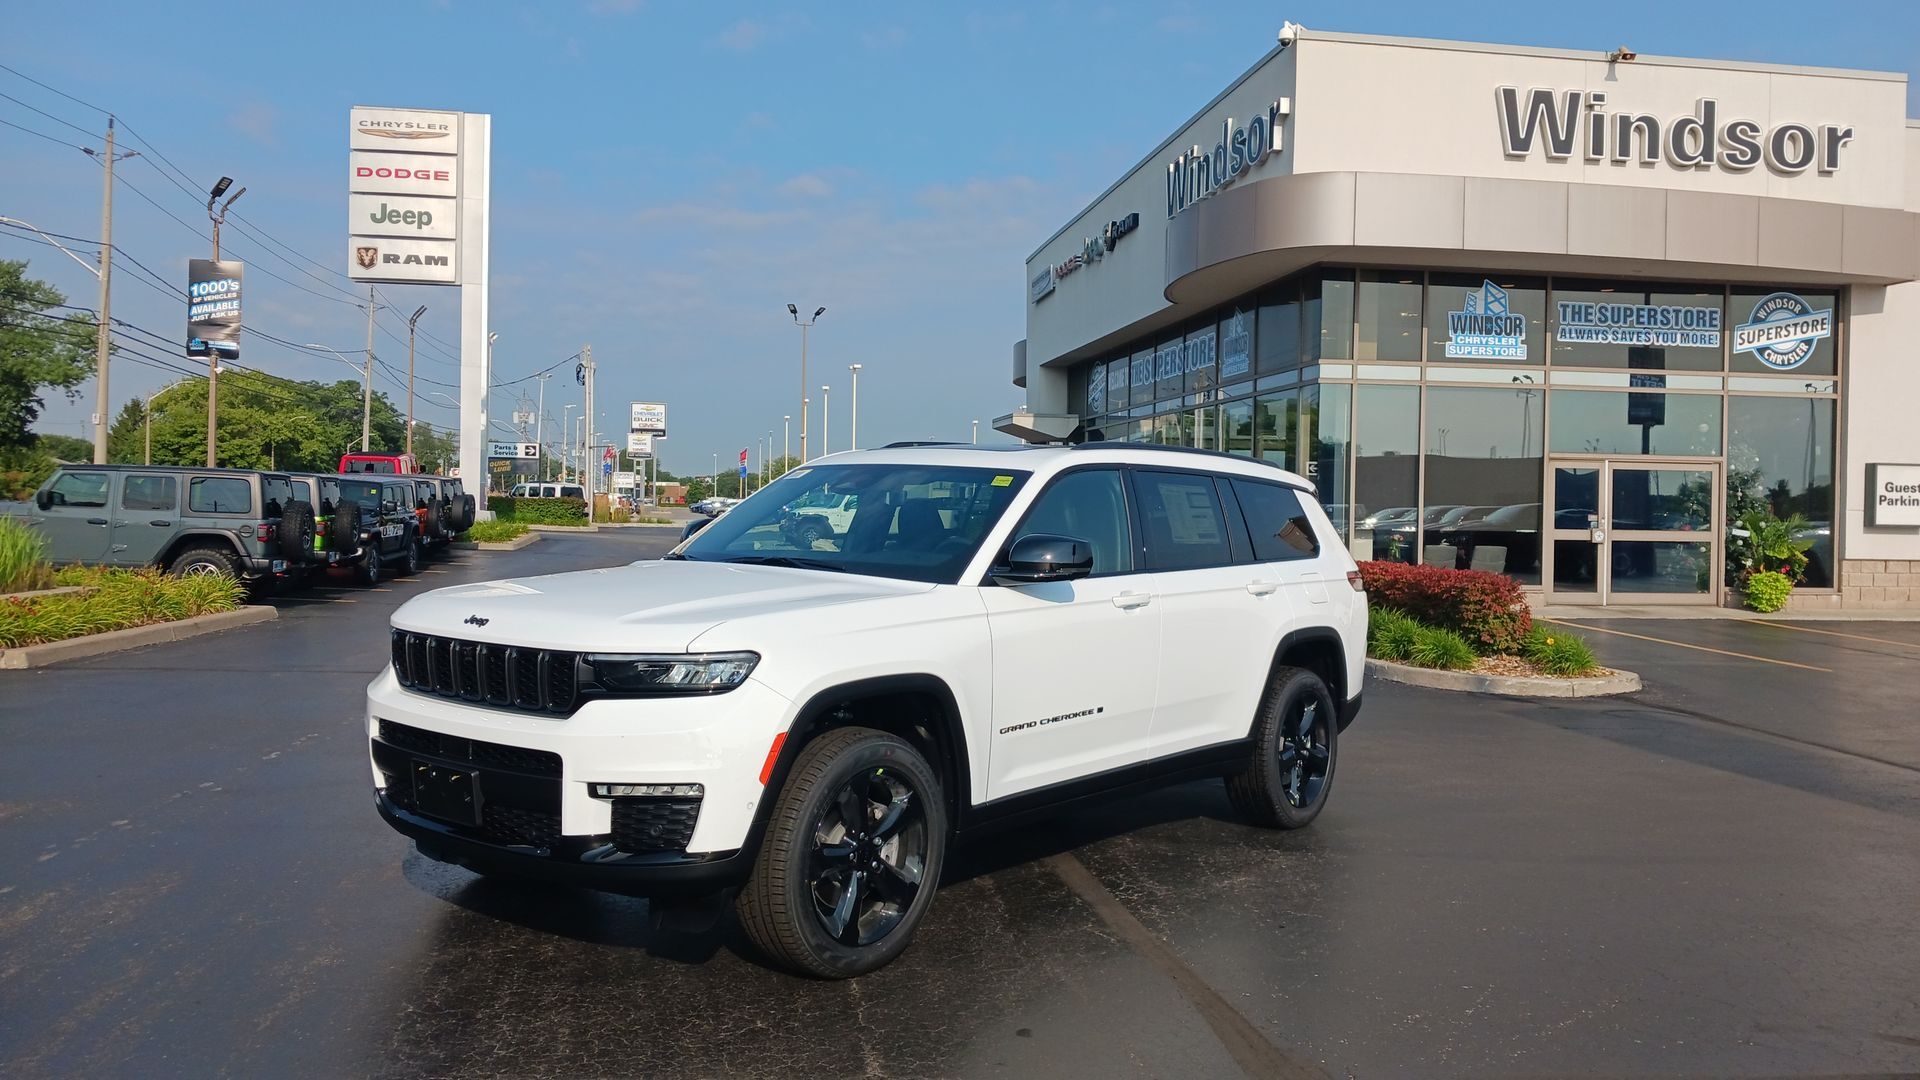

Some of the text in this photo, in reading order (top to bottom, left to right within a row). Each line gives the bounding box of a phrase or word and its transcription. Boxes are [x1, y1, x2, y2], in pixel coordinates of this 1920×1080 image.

[359, 120, 448, 131] CHRYSLER
[1496, 86, 1854, 172] Windsor
[1166, 97, 1290, 220] Windsor
[356, 167, 449, 181] DODGE
[370, 203, 432, 229] Jeep
[382, 253, 448, 266] RAM
[203, 292, 237, 301] VEHICLES
[192, 300, 239, 315] AVAILABLE
[1559, 303, 1719, 328] THE SUPERSTORE
[1757, 298, 1802, 319] WINDSOR
[1451, 315, 1522, 336] WINDSOR
[1738, 317, 1828, 346] SUPERSTORE
[1457, 336, 1516, 345] CHRYSLER
[1560, 328, 1719, 345] ALWAYS SAVES YOU MORE!
[1144, 332, 1216, 385] SUPERSTORE
[1449, 346, 1524, 356] SUPERSTORE
[1764, 342, 1809, 365] CHRYSLER
[1879, 495, 1920, 506] Parkin
[464, 614, 489, 628] Jeep
[1000, 721, 1037, 735] GRAND
[1039, 709, 1094, 725] CHEROKEE
